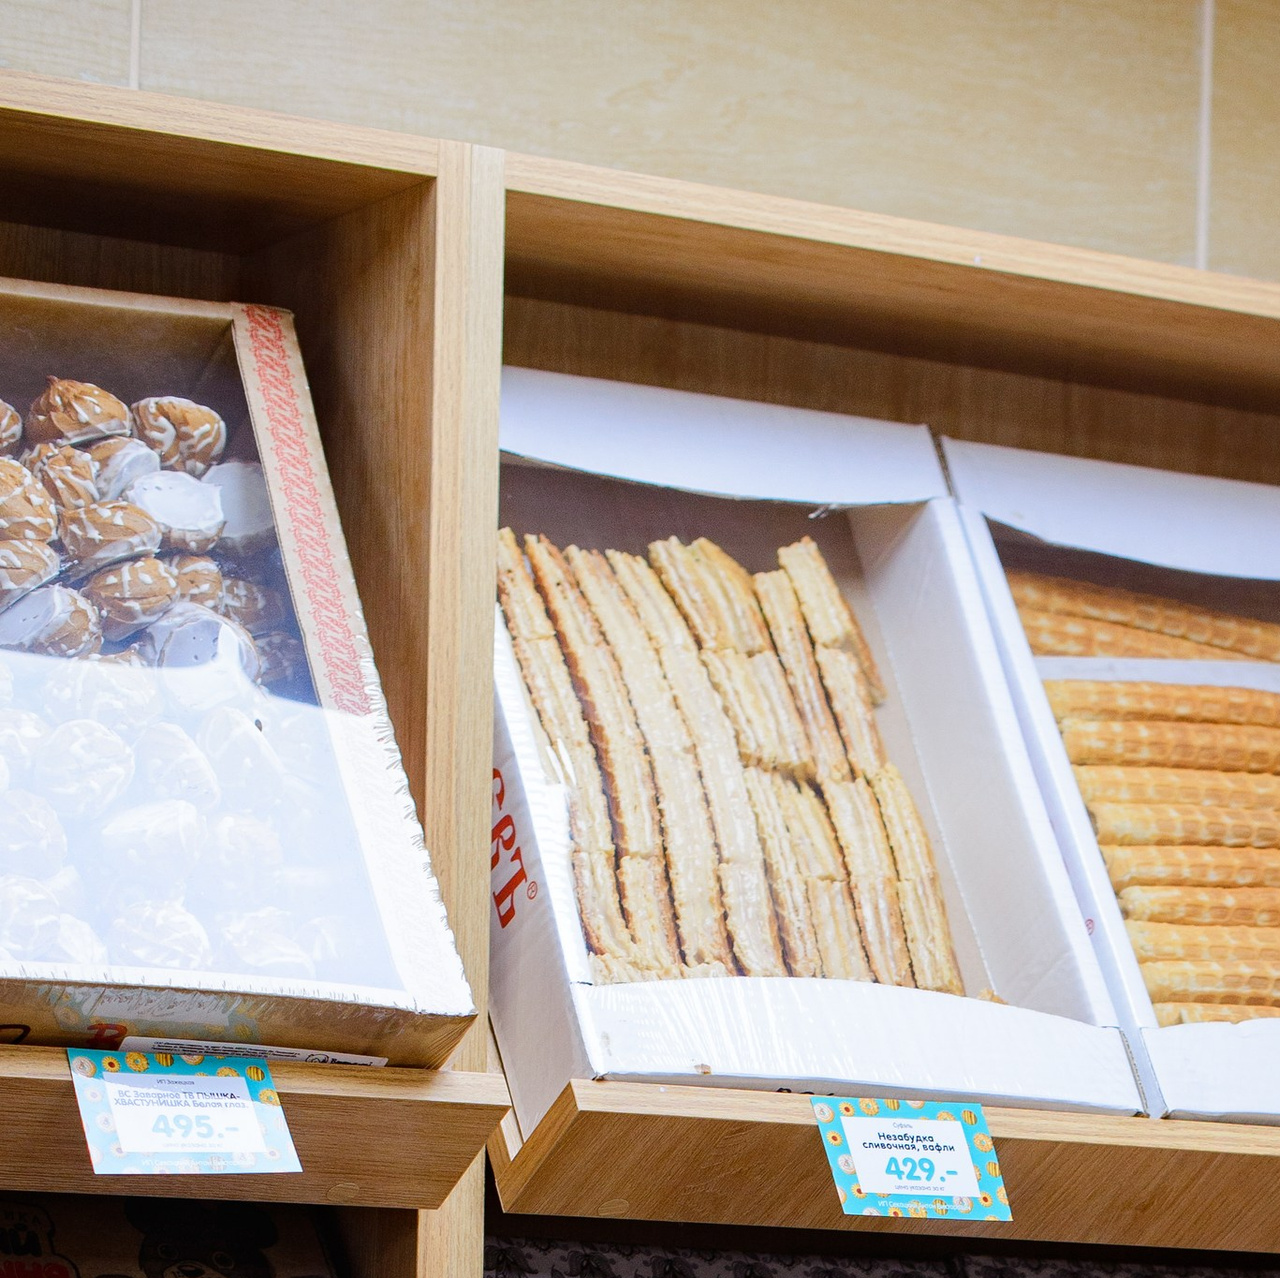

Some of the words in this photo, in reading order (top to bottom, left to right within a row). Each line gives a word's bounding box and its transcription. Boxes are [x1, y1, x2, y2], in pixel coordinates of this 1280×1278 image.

[878, 1132, 934, 1142] Незабудка
[863, 1142, 919, 1152] сливочная,
[923, 1144, 955, 1153] вафли
